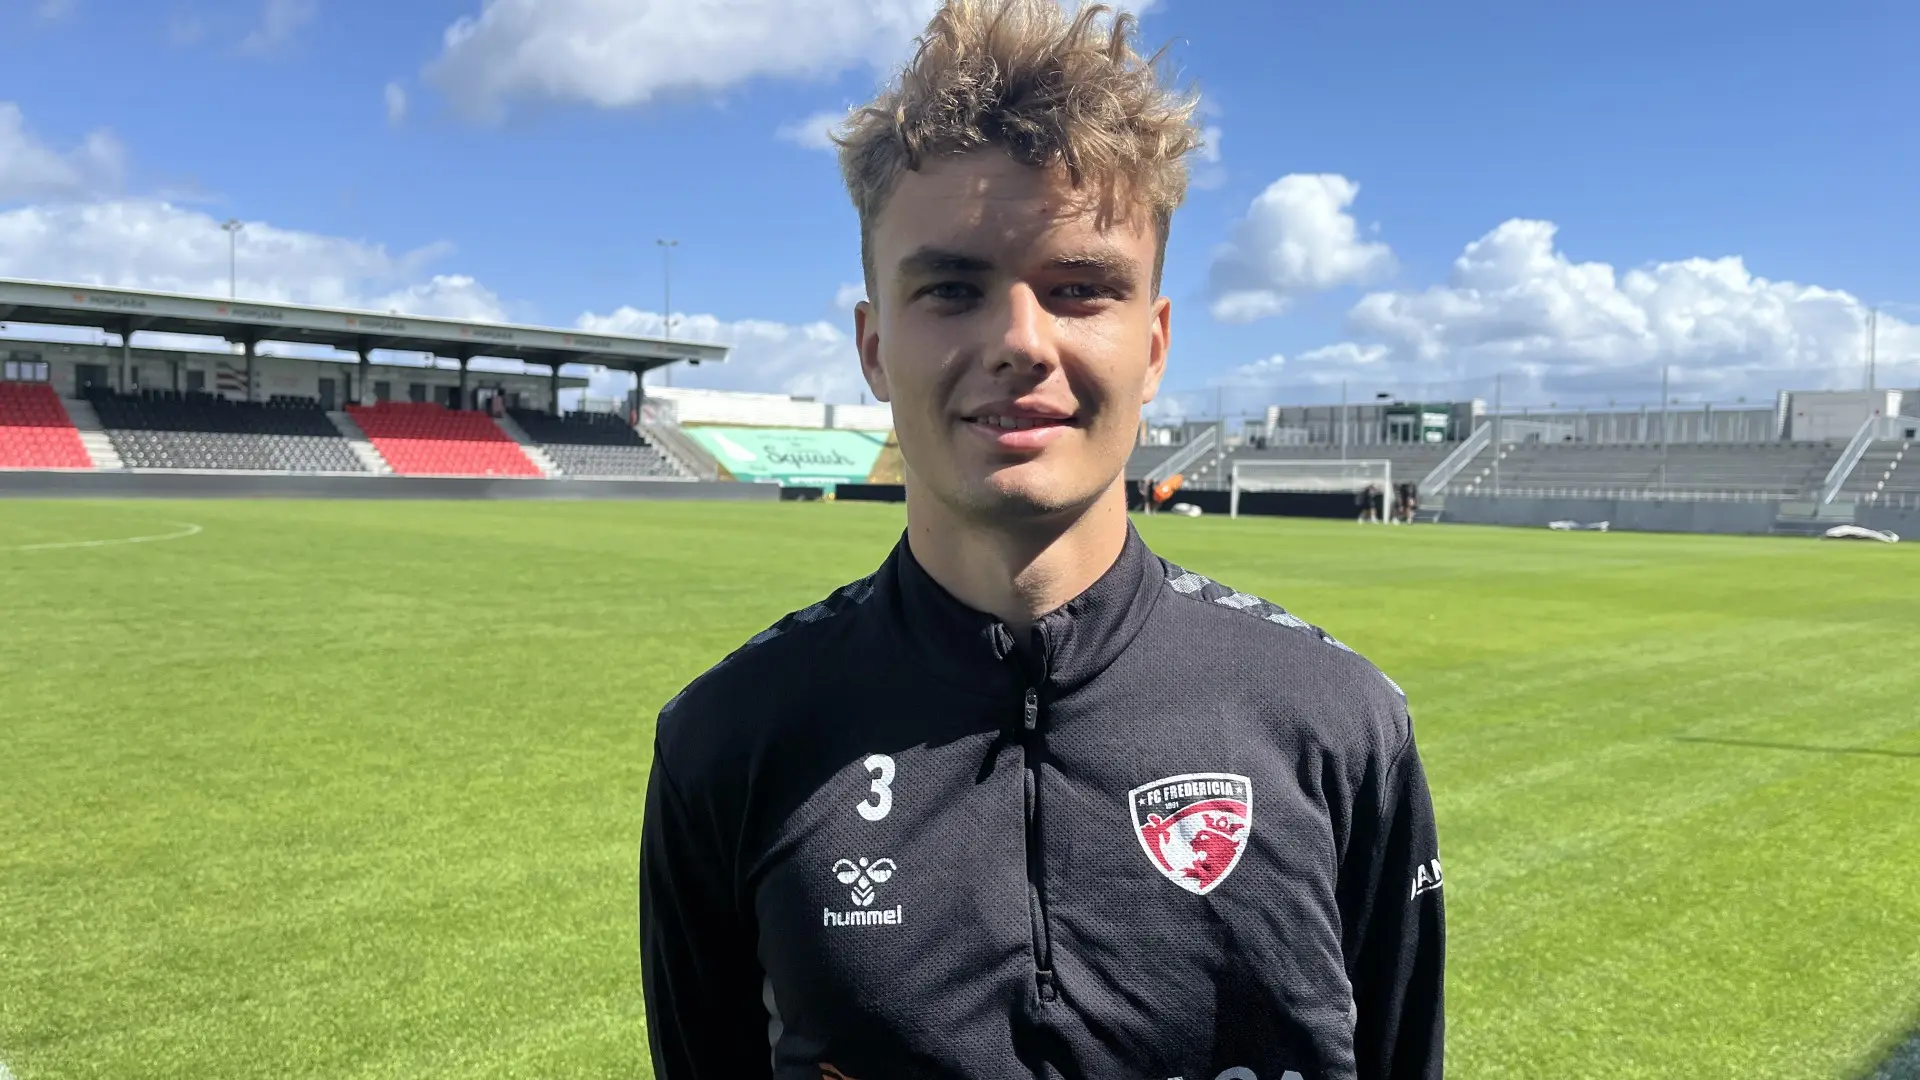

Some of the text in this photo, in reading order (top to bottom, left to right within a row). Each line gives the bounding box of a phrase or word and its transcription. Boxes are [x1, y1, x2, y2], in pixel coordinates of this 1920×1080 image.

[856, 753, 896, 821] 3
[1147, 781, 1234, 806] FC FREDERICIA
[823, 904, 902, 927] hummel
